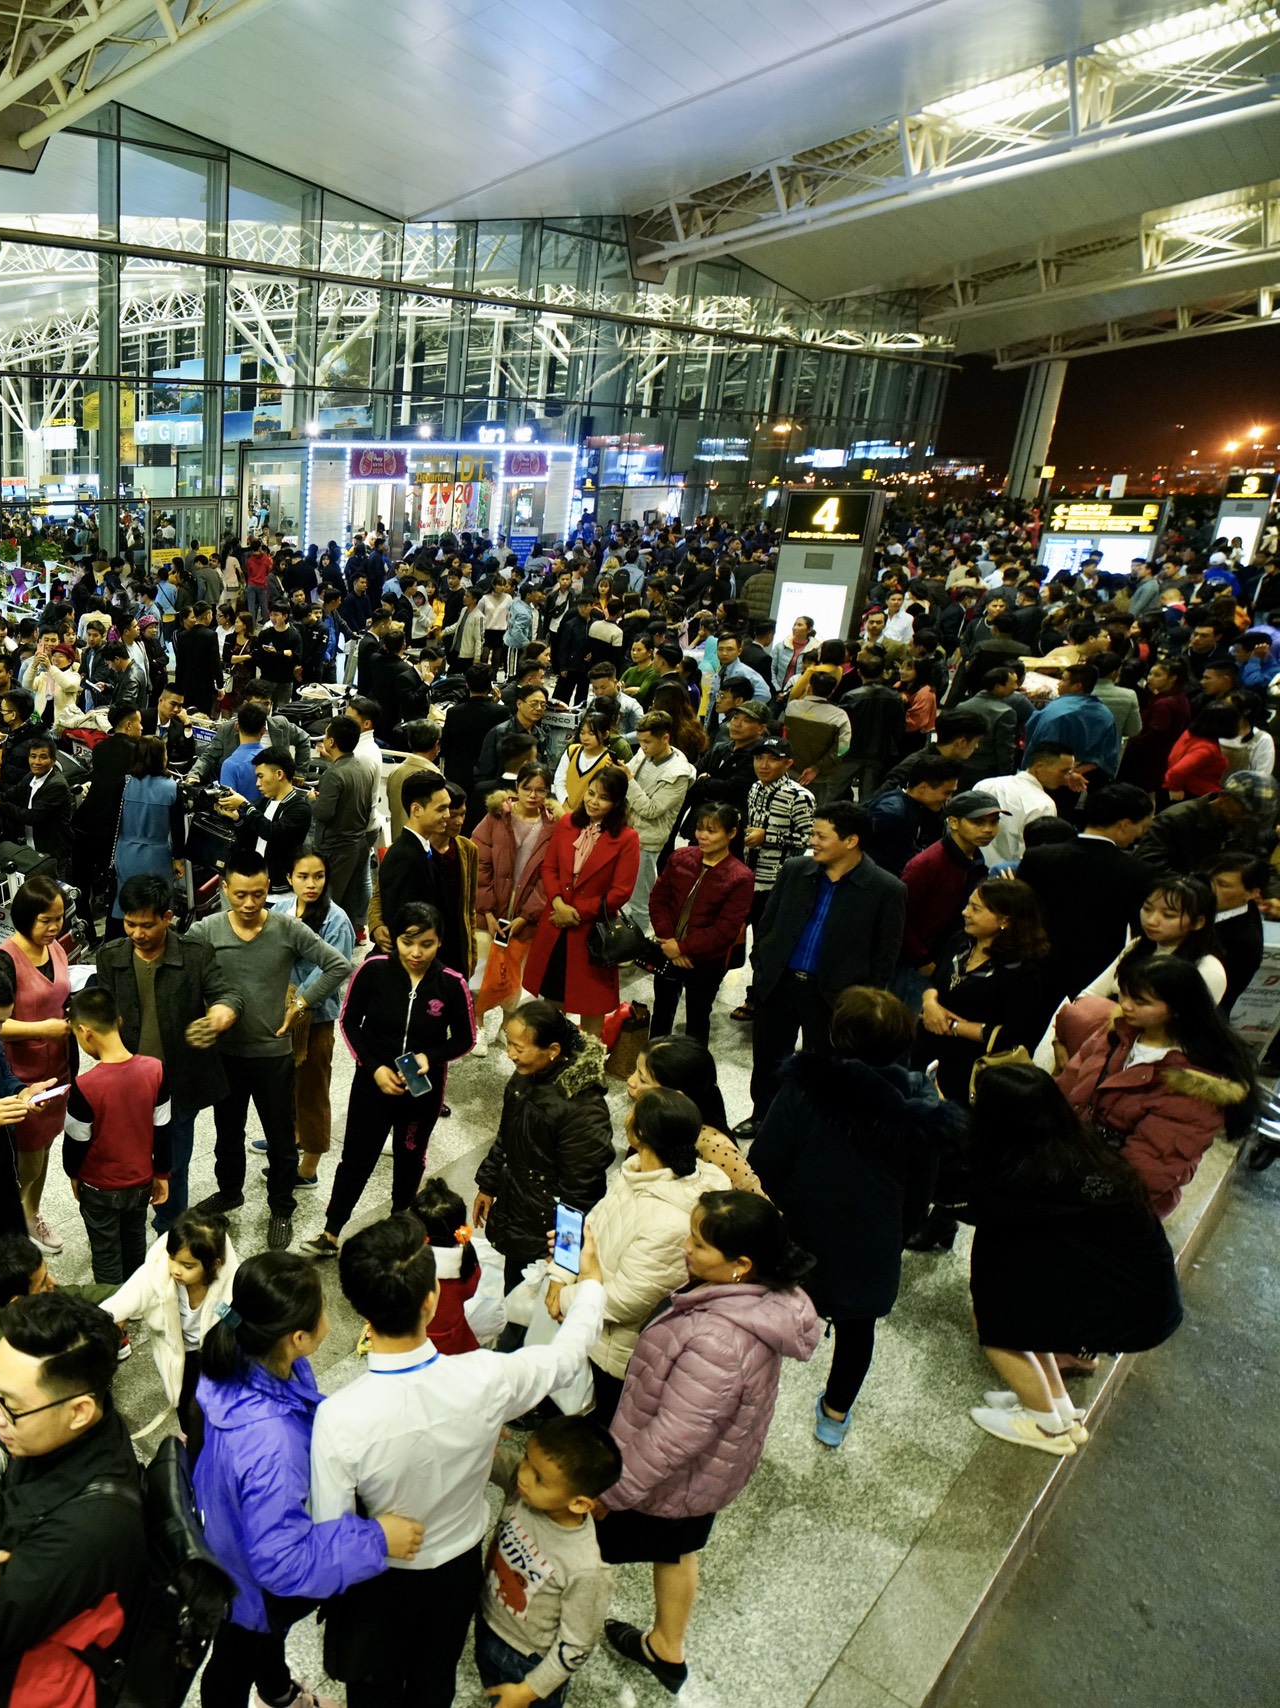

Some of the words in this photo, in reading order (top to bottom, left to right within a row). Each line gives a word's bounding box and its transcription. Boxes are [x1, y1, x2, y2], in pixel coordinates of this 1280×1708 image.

[159, 423, 170, 441] G
[460, 453, 484, 482] D1
[416, 472, 452, 483] Departure
[1241, 476, 1260, 495] 3
[811, 497, 840, 532] 4
